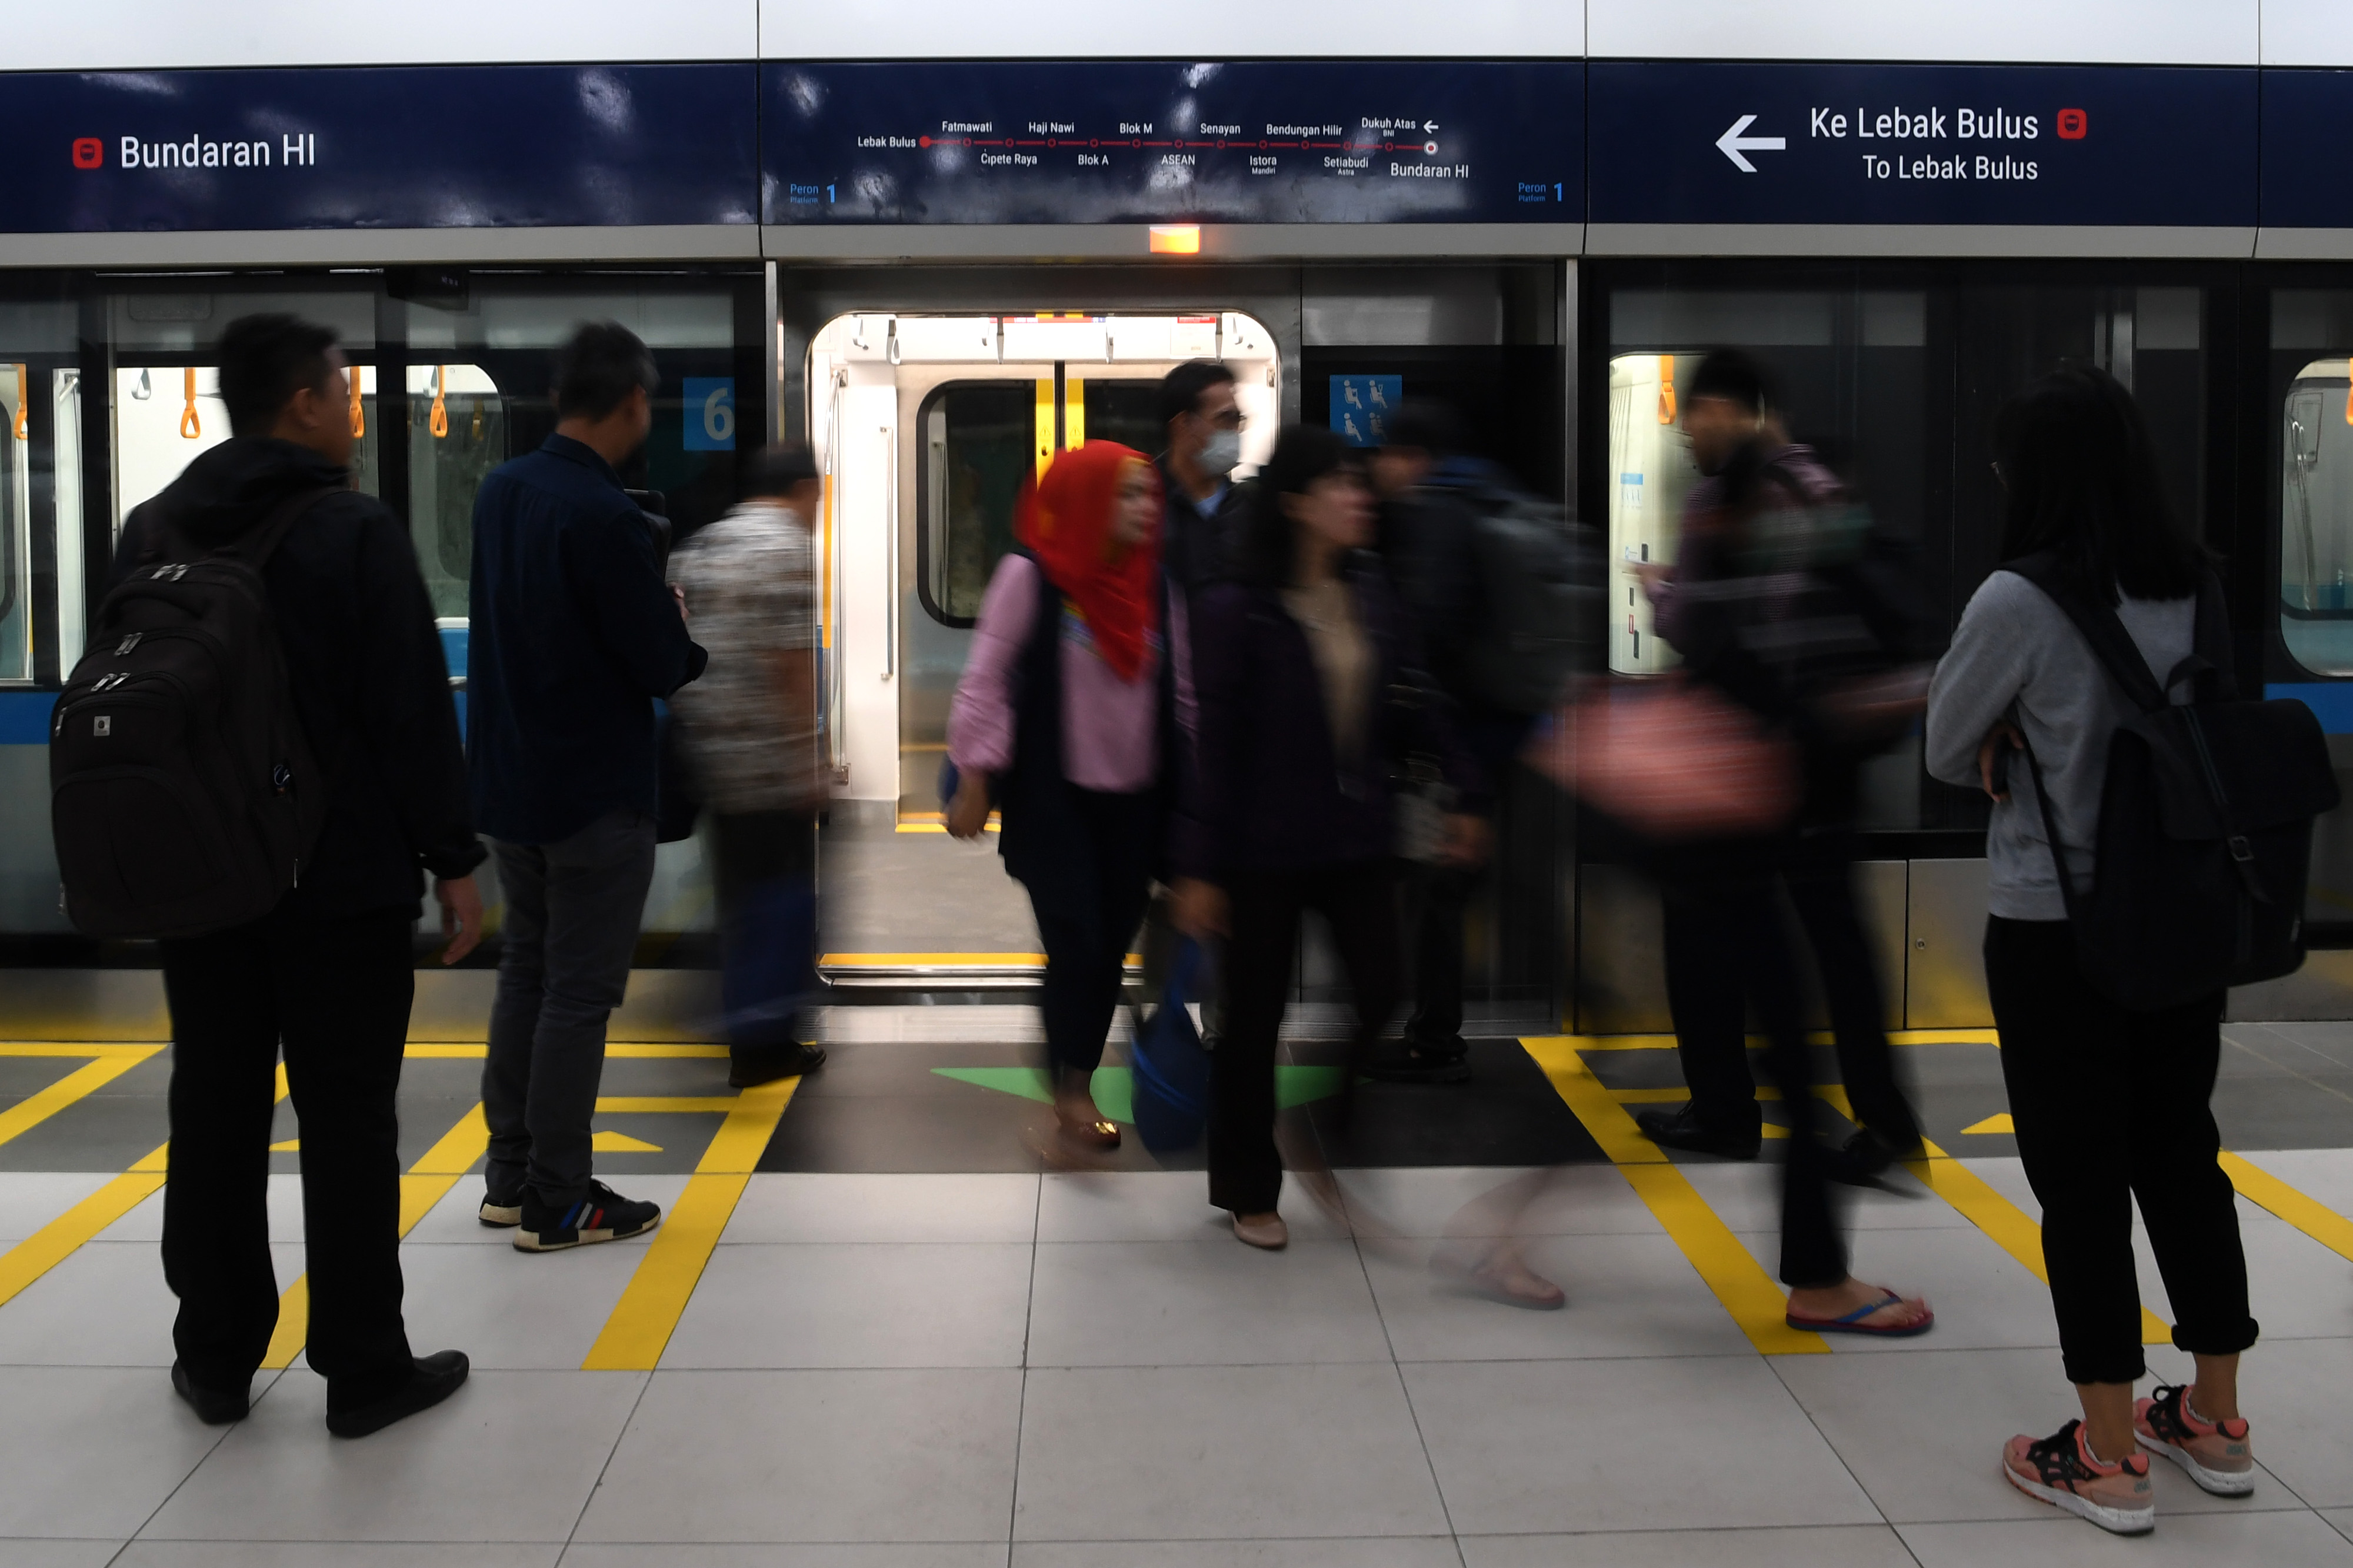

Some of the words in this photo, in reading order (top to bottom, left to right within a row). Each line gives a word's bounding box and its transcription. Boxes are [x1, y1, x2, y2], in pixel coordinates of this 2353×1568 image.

[942, 121, 992, 132] Fatmawati
[1029, 122, 1047, 135] Haji
[1051, 122, 1074, 133] Nawi
[1119, 122, 1141, 134] Blok
[1144, 123, 1152, 134] M
[1361, 117, 1391, 129] Dukuh
[1394, 118, 1416, 129] Atas
[1811, 108, 1847, 138] Ke
[1859, 106, 1947, 139] Lebak
[1958, 107, 2039, 139] Bulus
[1200, 123, 1241, 136] Senayan
[1267, 124, 1320, 138] Bendungan
[1323, 124, 1342, 136] Hilir
[858, 136, 886, 148] Lebak
[889, 136, 916, 148] Bulus
[121, 134, 270, 168] Bundaran
[283, 134, 315, 166] HI
[981, 151, 1012, 167] Cipete
[1015, 154, 1037, 167] Raya
[1078, 154, 1099, 165] Blok
[1102, 155, 1109, 165] A
[1161, 154, 1195, 165] ASEAN
[1249, 155, 1277, 166] Istora
[1324, 156, 1368, 168] Setiabudi
[1391, 162, 1451, 178] Bundaran
[1455, 164, 1469, 178] HI
[1862, 155, 1890, 179] To
[1899, 154, 1967, 179] Lebak
[1975, 155, 2038, 180] Bulus
[790, 184, 819, 195] Peron
[826, 184, 835, 203] 1
[1518, 182, 1546, 193] Peron
[1554, 182, 1562, 202] 1
[1518, 194, 1546, 202] Platform
[704, 387, 735, 441] 6
